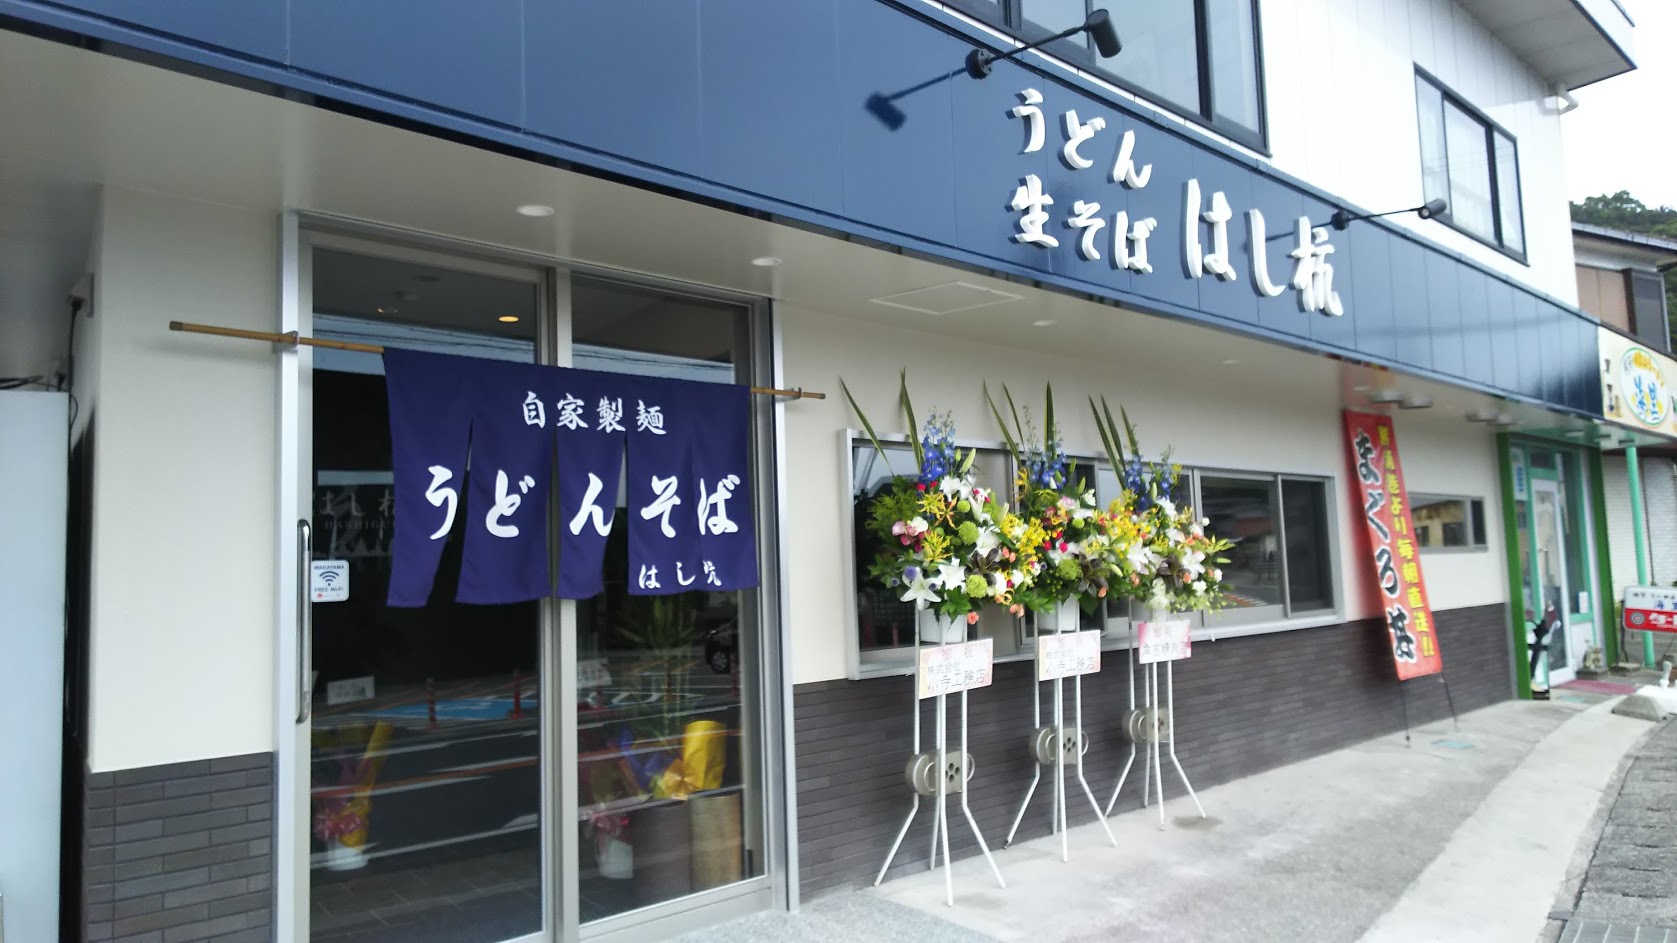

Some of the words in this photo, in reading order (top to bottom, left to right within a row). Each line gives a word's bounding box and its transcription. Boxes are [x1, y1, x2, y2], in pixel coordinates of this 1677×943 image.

[1010, 88, 1152, 189] うどん
[1010, 174, 1158, 274] 生そば
[1184, 178, 1344, 317] はし杭
[521, 391, 667, 435] 自家製麺
